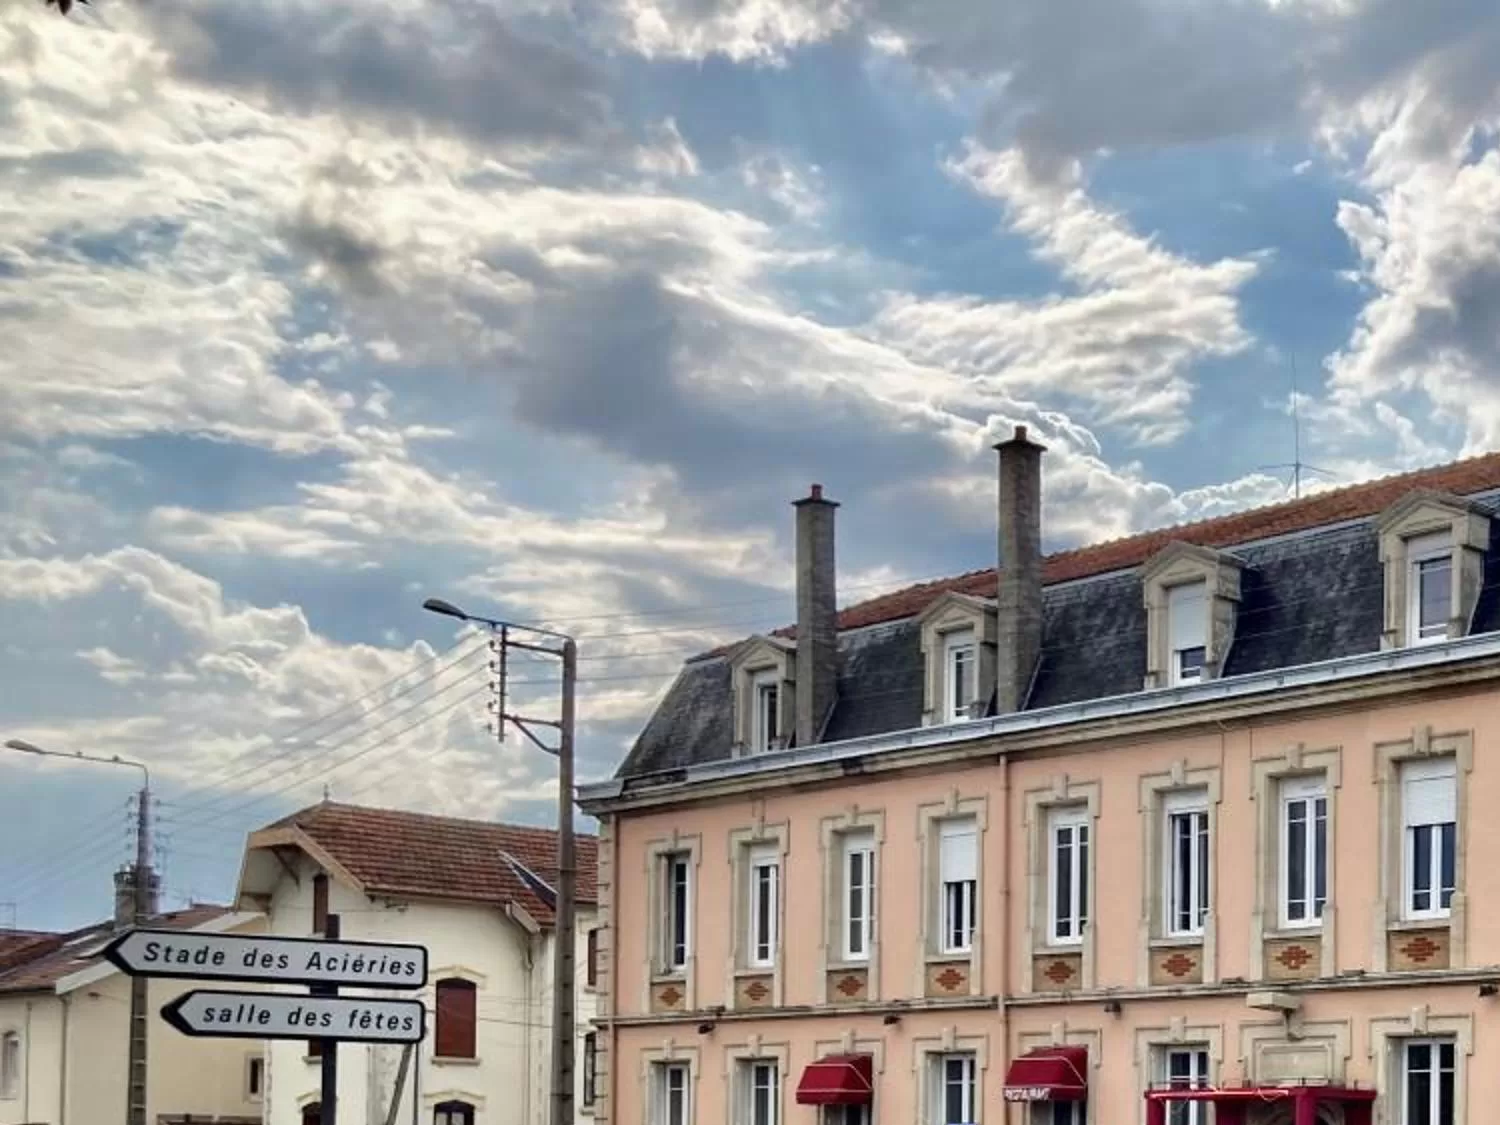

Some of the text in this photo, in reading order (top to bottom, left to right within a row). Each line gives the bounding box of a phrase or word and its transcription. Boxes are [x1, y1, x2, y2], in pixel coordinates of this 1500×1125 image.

[143, 942, 417, 977] Stade des Aciéries
[203, 1004, 414, 1032] salle des fêtes
